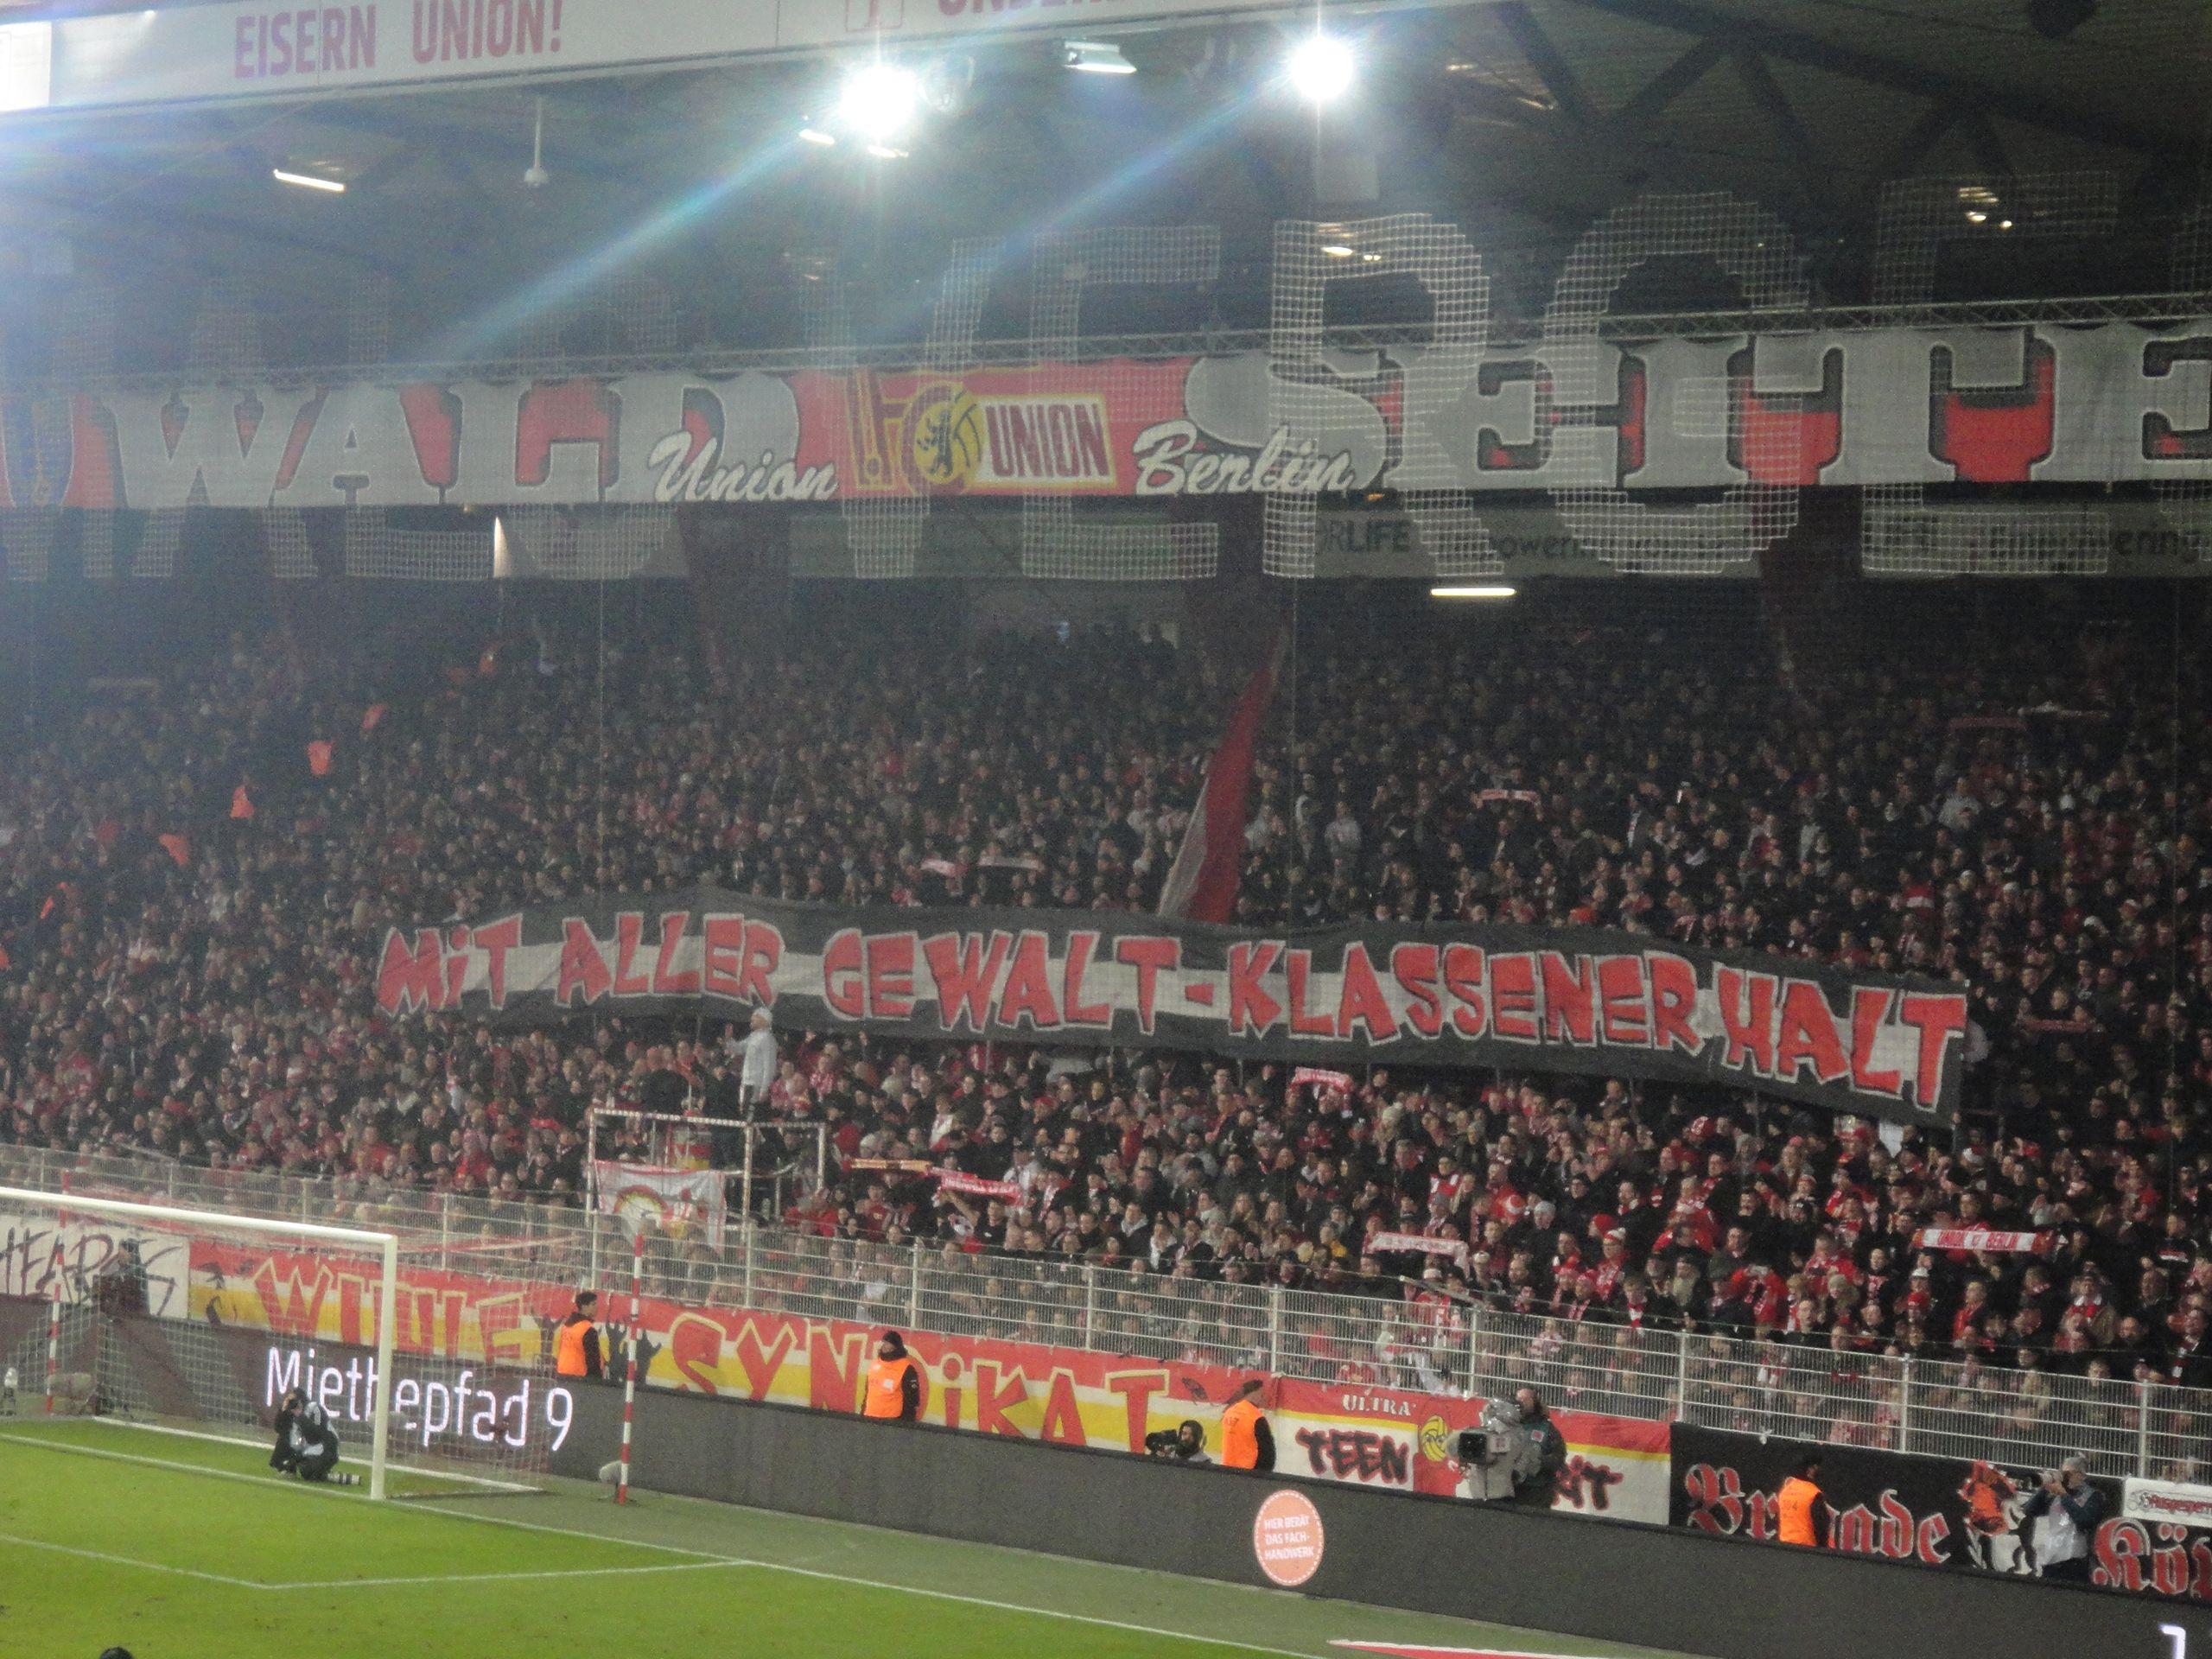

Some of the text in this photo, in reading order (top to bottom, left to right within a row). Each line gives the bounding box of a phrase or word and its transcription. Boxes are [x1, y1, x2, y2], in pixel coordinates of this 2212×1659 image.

[234, 0, 563, 79] EISERN UNION!
[648, 430, 838, 503] Union
[985, 403, 1111, 477] UNION
[1132, 419, 1353, 495] Berlin
[553, 911, 785, 1007] ALLER
[545, 1386, 574, 1452] 9
[1296, 1427, 1409, 1484] TEEN
[1264, 1533, 1283, 1546] DAS
[1685, 1463, 1951, 1564] Brade
[1264, 1545, 1314, 1560] HANDWERK
